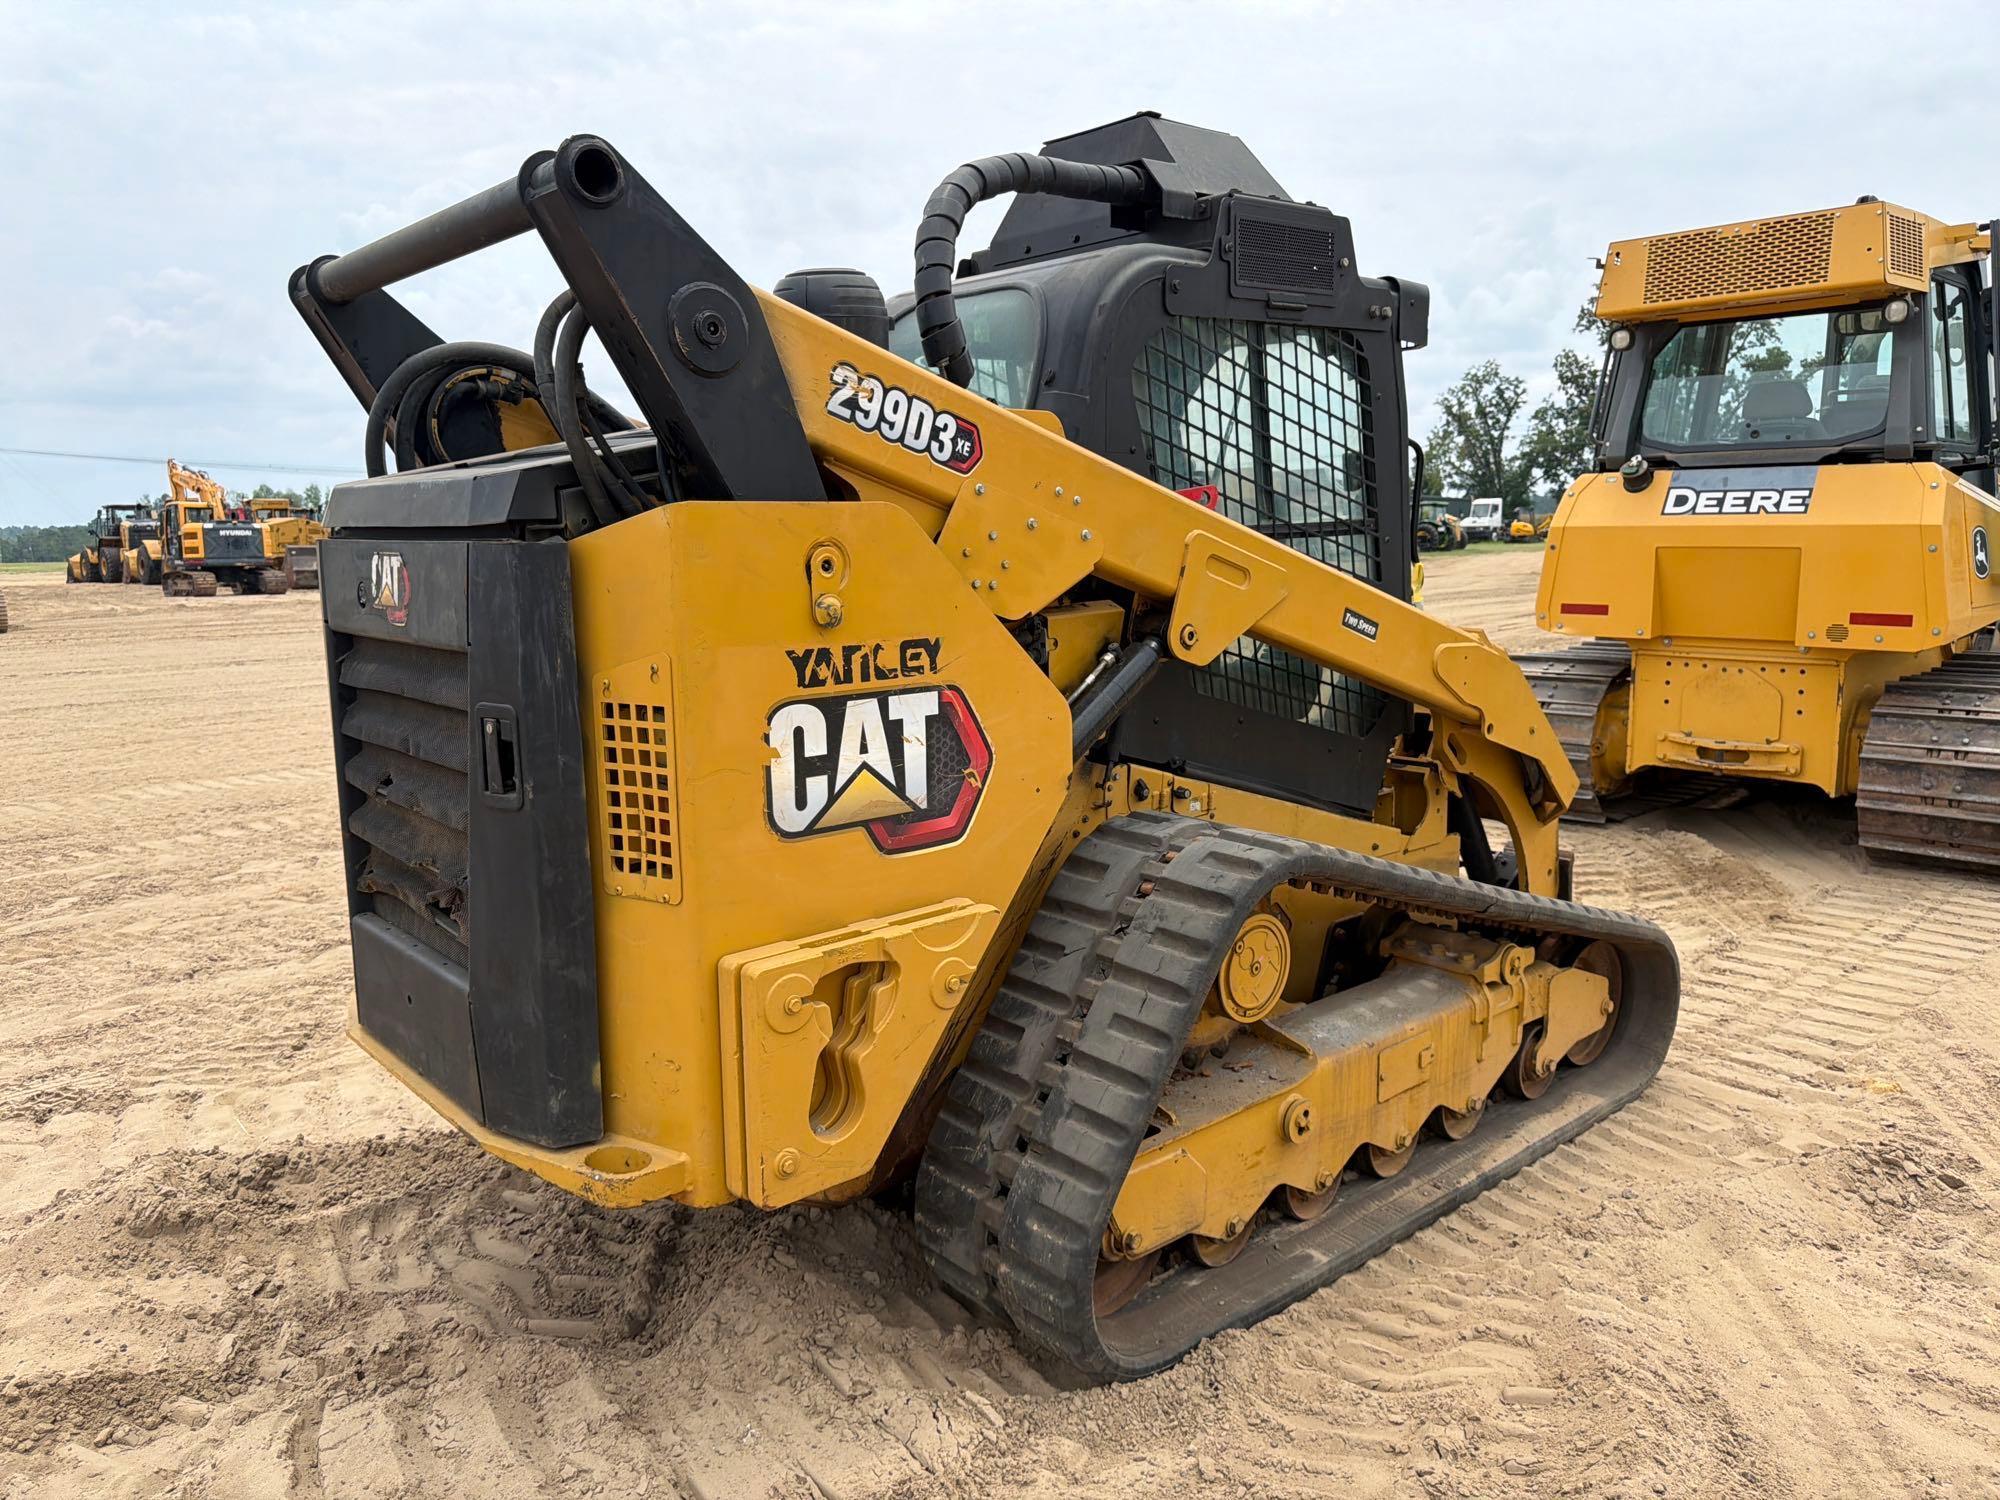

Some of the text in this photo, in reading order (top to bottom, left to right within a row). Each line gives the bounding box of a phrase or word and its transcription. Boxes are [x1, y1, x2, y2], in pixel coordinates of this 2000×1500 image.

[827, 366, 971, 462] 299D3 XE
[1663, 488, 1812, 515] DEERE
[1345, 612, 1376, 636] TWO SPEED
[769, 691, 938, 832] CAT
